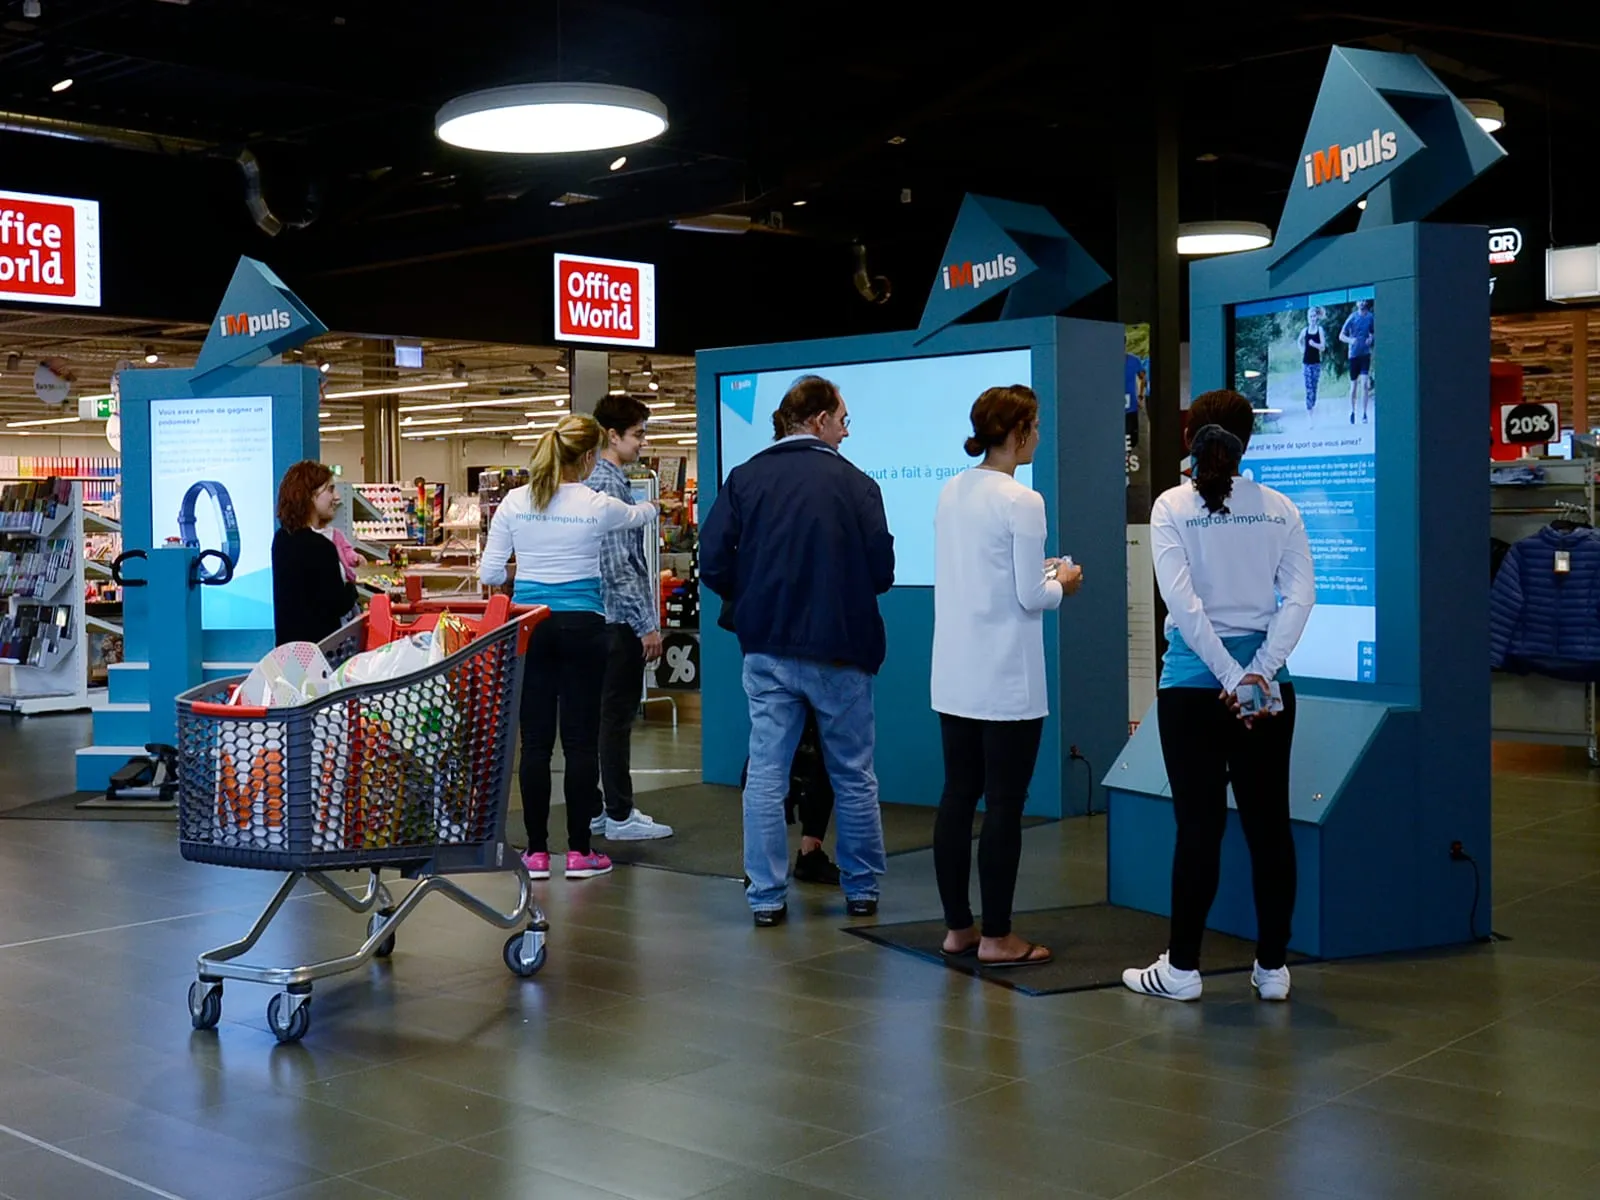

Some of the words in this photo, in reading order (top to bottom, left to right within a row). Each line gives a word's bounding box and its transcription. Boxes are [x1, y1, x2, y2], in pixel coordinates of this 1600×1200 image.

[1304, 128, 1397, 188] iMpuls
[0, 209, 62, 250] fice
[1488, 234, 1515, 252] OR
[0, 249, 64, 285] orld
[943, 253, 1017, 290] iMpuls
[567, 271, 632, 302] Office
[220, 308, 291, 337] iMpuls
[567, 300, 634, 331] World
[1509, 414, 1550, 435] 20%
[1272, 443, 1285, 452] type
[1286, 442, 1294, 450] de
[1295, 441, 1311, 451] sport
[891, 466, 898, 479] à
[901, 466, 921, 478] fait
[924, 465, 932, 478] à
[515, 512, 598, 525] migros-impuls.ch
